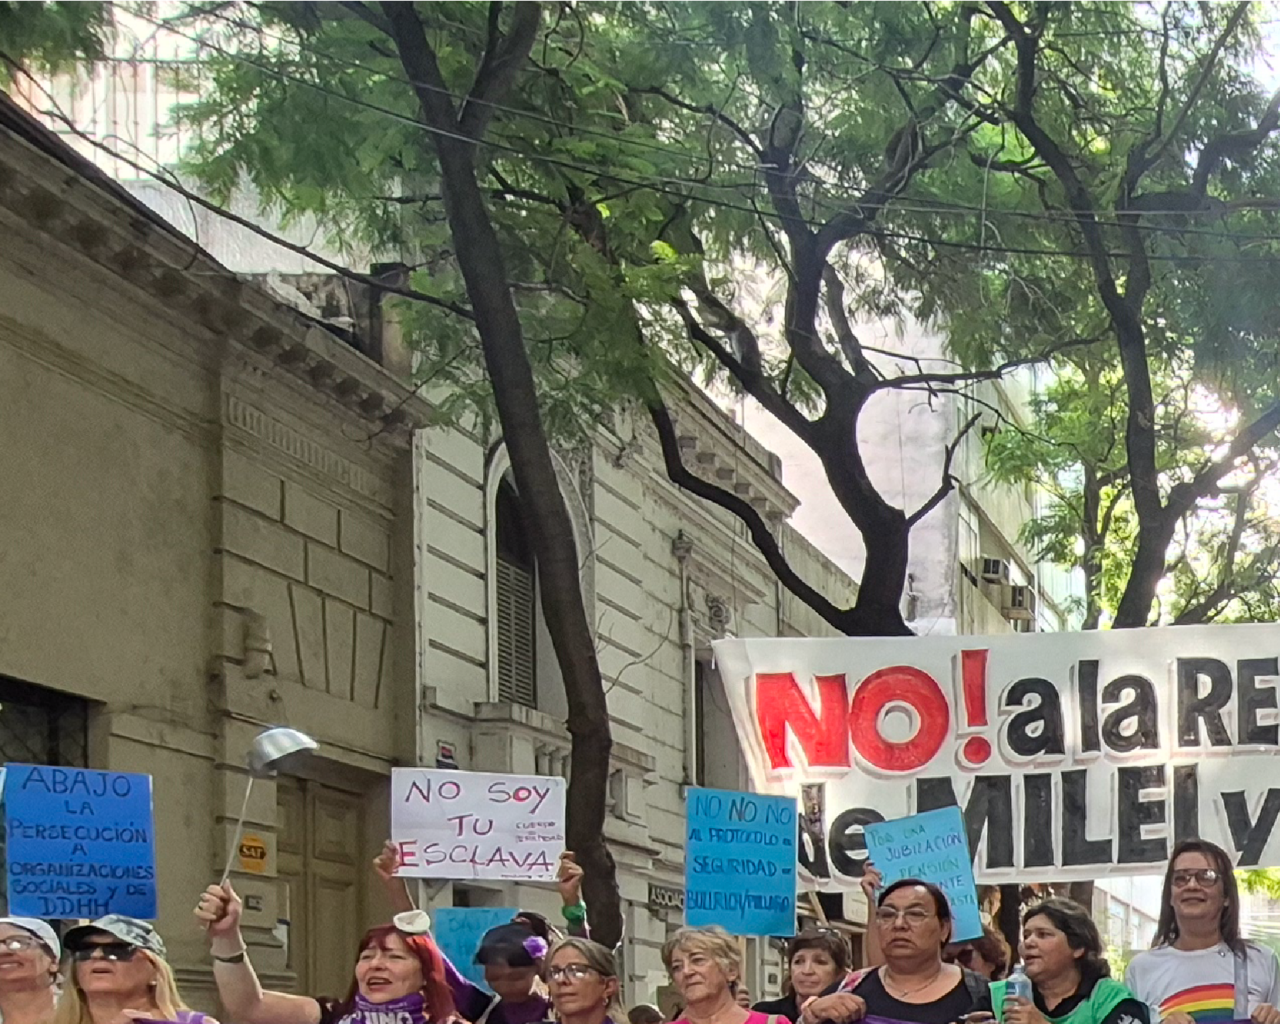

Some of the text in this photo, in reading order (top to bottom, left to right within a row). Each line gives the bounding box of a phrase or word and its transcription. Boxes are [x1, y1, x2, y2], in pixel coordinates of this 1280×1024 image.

[754, 648, 992, 773] NO!
[1005, 676, 1064, 757] a
[1076, 659, 1160, 754] la
[22, 766, 131, 797] ABAJO
[405, 778, 461, 803] NO
[64, 800, 94, 816] LA
[696, 794, 792, 825] NO NO NO
[916, 763, 1200, 869] MILEI
[447, 813, 493, 837] TU
[71, 843, 87, 856] A
[398, 839, 554, 874] ESCLAVA
[886, 827, 962, 861] JUBILACIÓN
[126, 883, 147, 896] DE
[37, 896, 110, 916] DDHH
